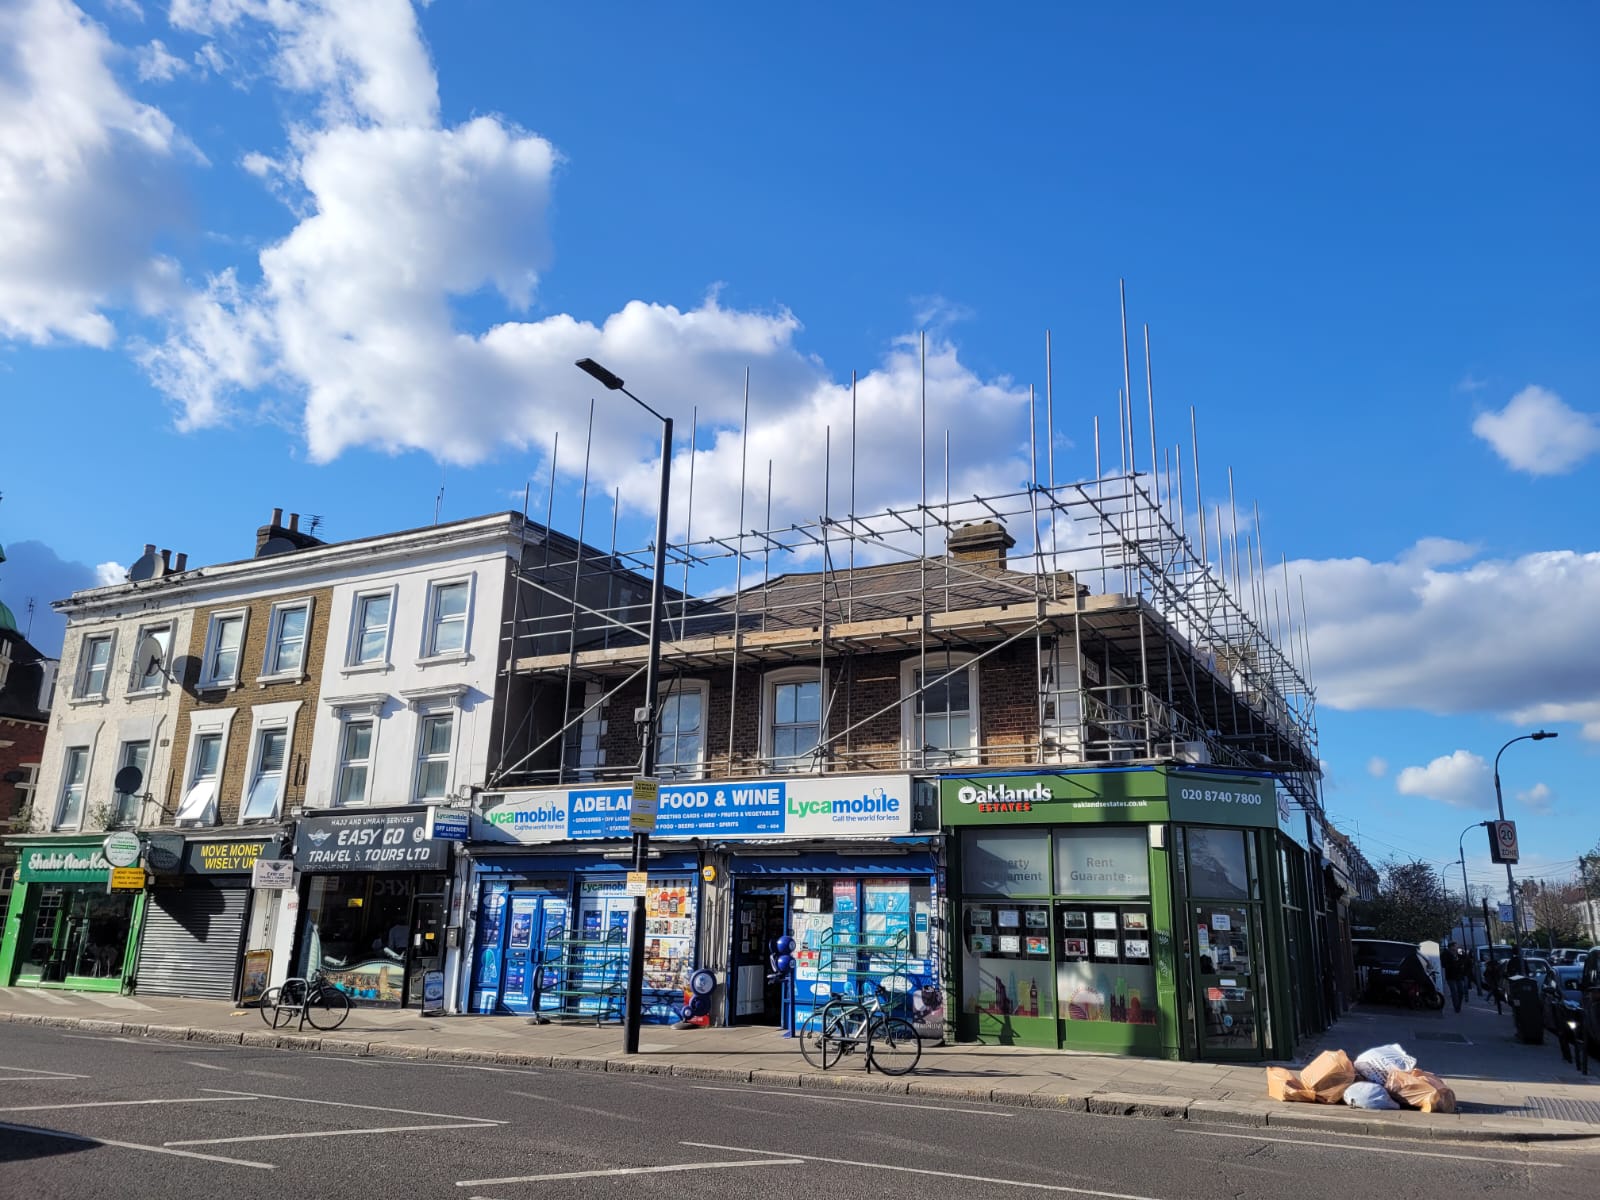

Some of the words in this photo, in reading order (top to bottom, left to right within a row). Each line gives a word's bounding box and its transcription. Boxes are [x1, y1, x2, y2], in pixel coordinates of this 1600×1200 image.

[660, 791, 709, 809] FOOD
[714, 790, 727, 807] &
[732, 788, 780, 806] WINE
[958, 782, 1052, 804] Oaklands
[1181, 788, 1203, 801] 020
[1204, 790, 1232, 803] 8740
[1234, 793, 1262, 805] 7800
[787, 794, 899, 818] Lycamobile
[978, 802, 1031, 812] ESTATES
[1073, 799, 1148, 809] oaklandsestates.co.uk
[338, 828, 381, 846] EASY
[383, 828, 405, 845] GO
[1501, 829, 1513, 841] 20
[201, 844, 227, 857] MOVE
[229, 843, 266, 856] MONEY
[308, 850, 351, 862] TRAVEL
[355, 850, 361, 862] &
[364, 848, 407, 862] TOURS
[406, 847, 430, 861] LTD
[28, 852, 64, 870] Shahi
[205, 857, 240, 869] WISELY
[242, 857, 257, 869] UK
[1087, 857, 1113, 868] Rent
